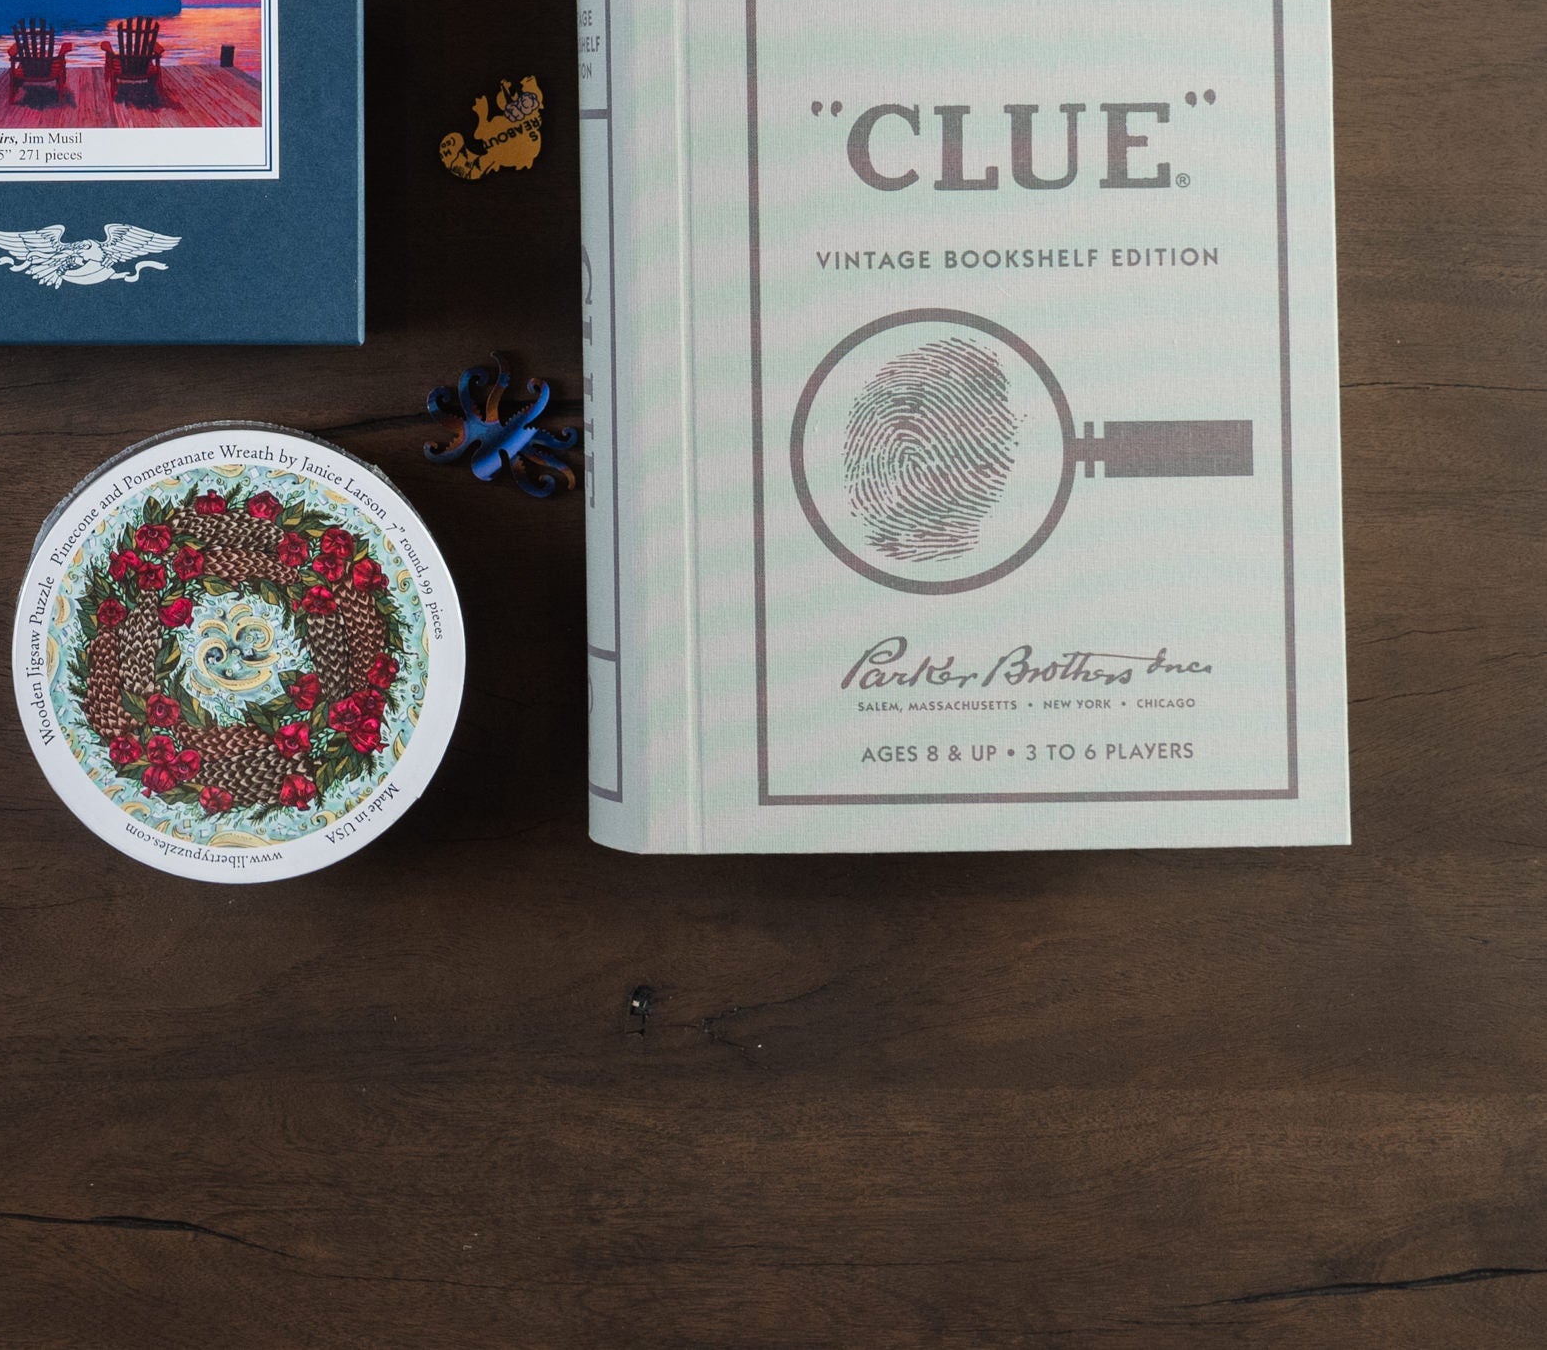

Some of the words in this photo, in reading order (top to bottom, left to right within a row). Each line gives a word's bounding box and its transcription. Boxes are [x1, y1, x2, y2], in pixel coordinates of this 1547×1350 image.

[22, 132, 45, 144] Jim
[48, 131, 83, 144] Musil
[19, 148, 41, 161] 271
[44, 147, 83, 163] pieces
[815, 250, 931, 271] VINTAGE
[944, 248, 1099, 269] BOOKSHELF
[1111, 247, 1220, 268] EDITION
[219, 444, 274, 462] Wreath
[279, 446, 298, 467] by
[122, 449, 215, 490] Pomegranate
[301, 456, 343, 486] Janice
[100, 484, 124, 510] and
[344, 478, 387, 521] Larson
[50, 507, 100, 567] Pinecone
[400, 535, 429, 580] round,
[29, 575, 56, 627] Puzzle
[420, 579, 434, 596] 99
[425, 601, 446, 641] pieces
[26, 629, 42, 679] Jigsaw
[840, 635, 978, 690] Parker
[981, 644, 1134, 688] Brothers
[29, 680, 56, 747] Wooden
[857, 701, 903, 714] SALEM,
[908, 700, 1018, 712] MASSACHUSETTS
[1043, 699, 1071, 710] NEW
[1077, 698, 1111, 710] YORK
[1136, 697, 1196, 709] CHICAGO
[861, 745, 918, 764] AGES
[926, 745, 939, 763] 8
[947, 745, 963, 762] &
[970, 745, 998, 762] UP
[1025, 744, 1038, 762] 3
[1046, 743, 1076, 762] TO
[1084, 743, 1097, 761] 6
[1106, 742, 1195, 761] PLAYERS
[369, 782, 402, 814] Made
[325, 820, 357, 845] USA
[354, 810, 372, 825] in
[125, 822, 283, 869] www.libertypuzzles.com
